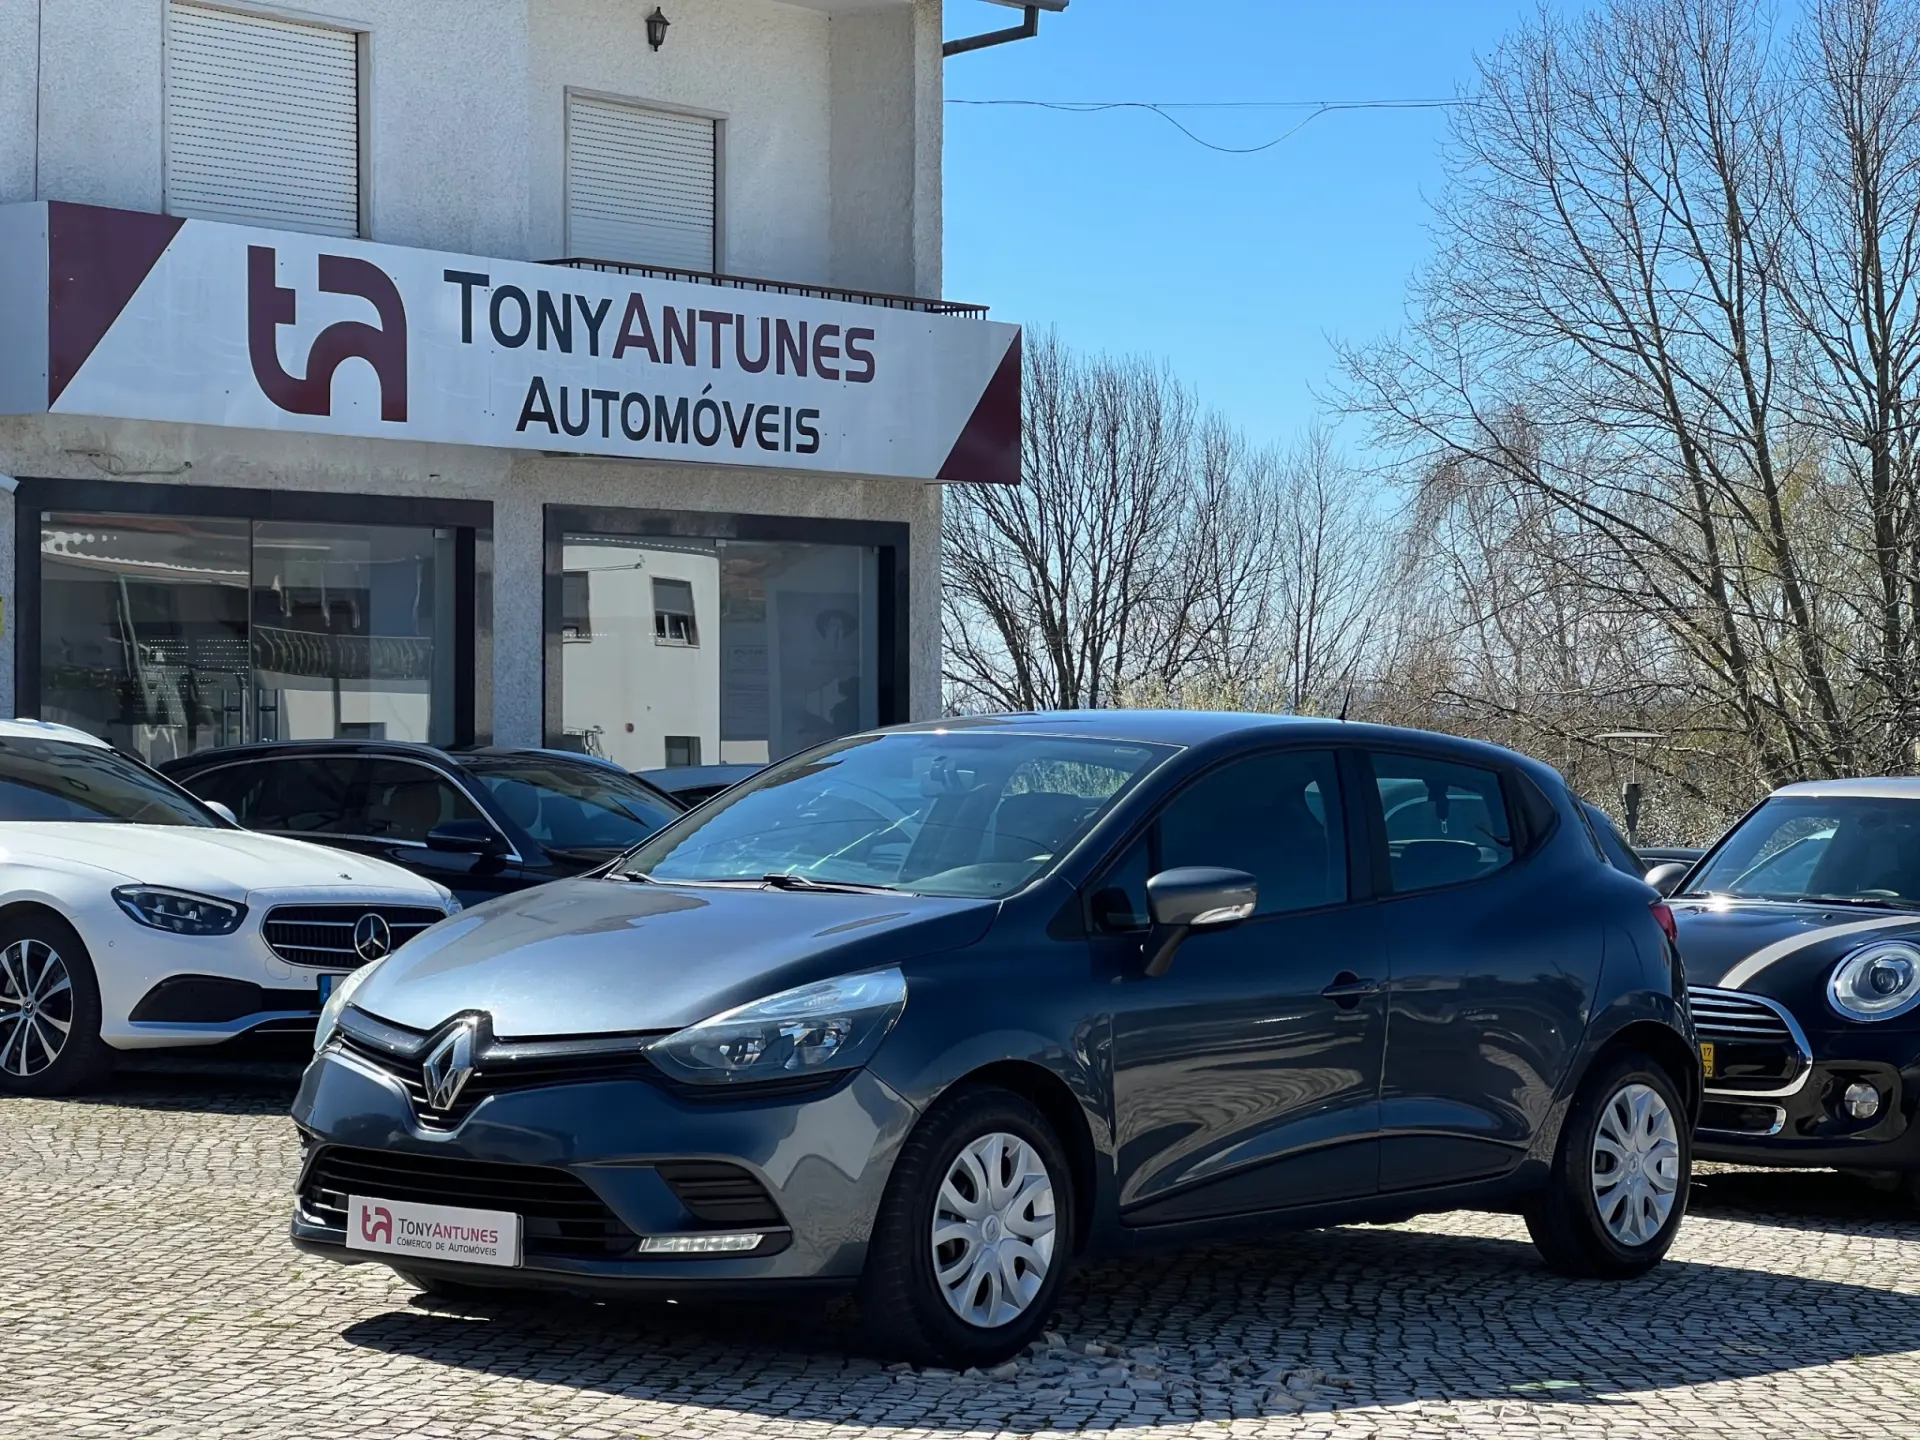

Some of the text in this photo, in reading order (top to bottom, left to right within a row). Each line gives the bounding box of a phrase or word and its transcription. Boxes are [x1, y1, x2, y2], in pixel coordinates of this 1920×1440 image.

[515, 376, 820, 454] AUTOMÓVEIS
[1703, 1047, 1712, 1056] 17
[435, 1241, 445, 1251] DE
[447, 1242, 497, 1257] AUTOMÓVEIS
